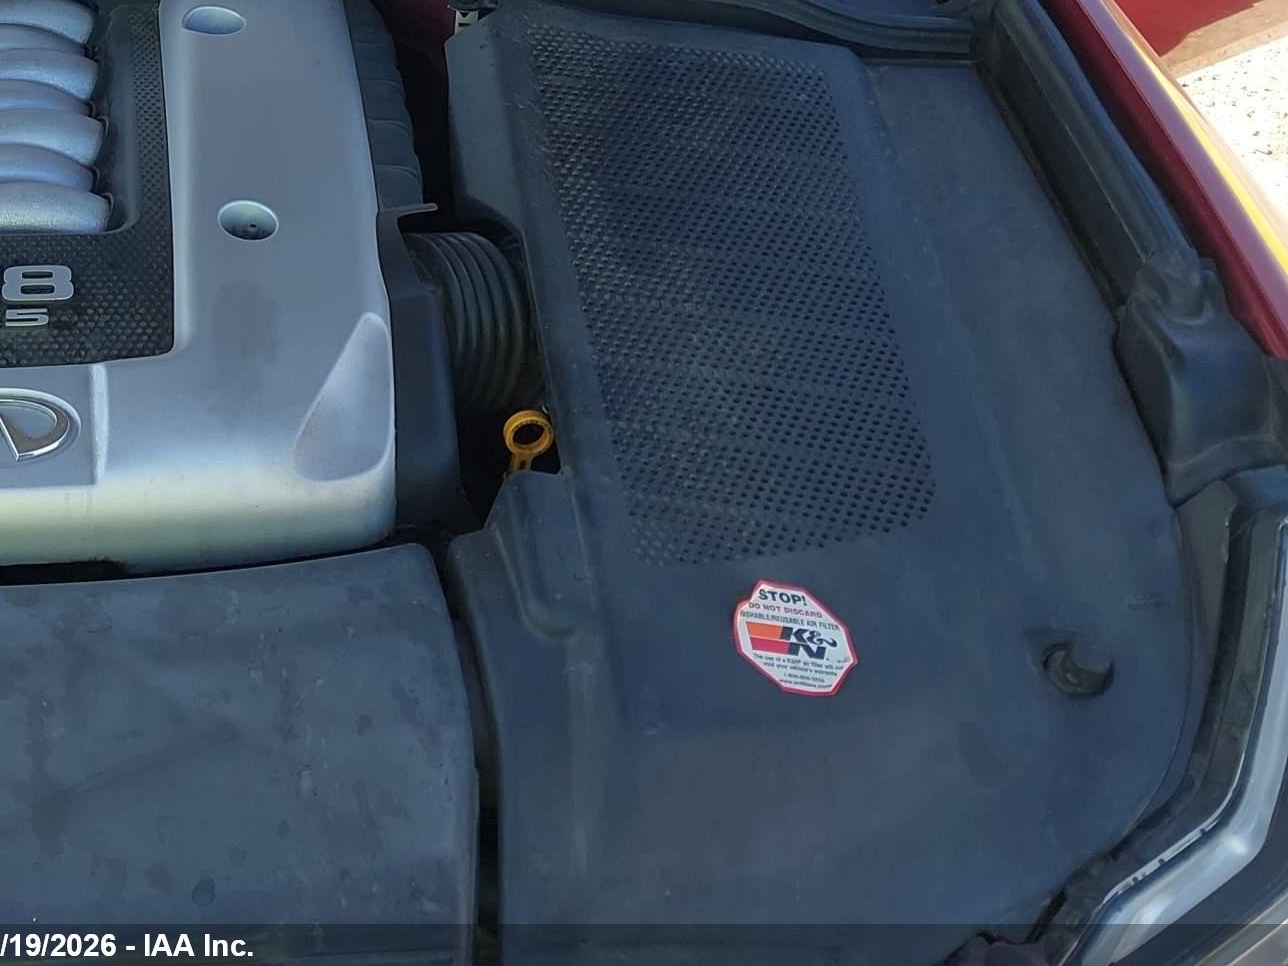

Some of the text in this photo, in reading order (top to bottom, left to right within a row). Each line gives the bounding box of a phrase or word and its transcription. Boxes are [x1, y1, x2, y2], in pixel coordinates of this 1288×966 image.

[758, 588, 808, 607] STOP!
[748, 602, 823, 619] DO NOT DISCARD
[818, 622, 841, 632] FILTER
